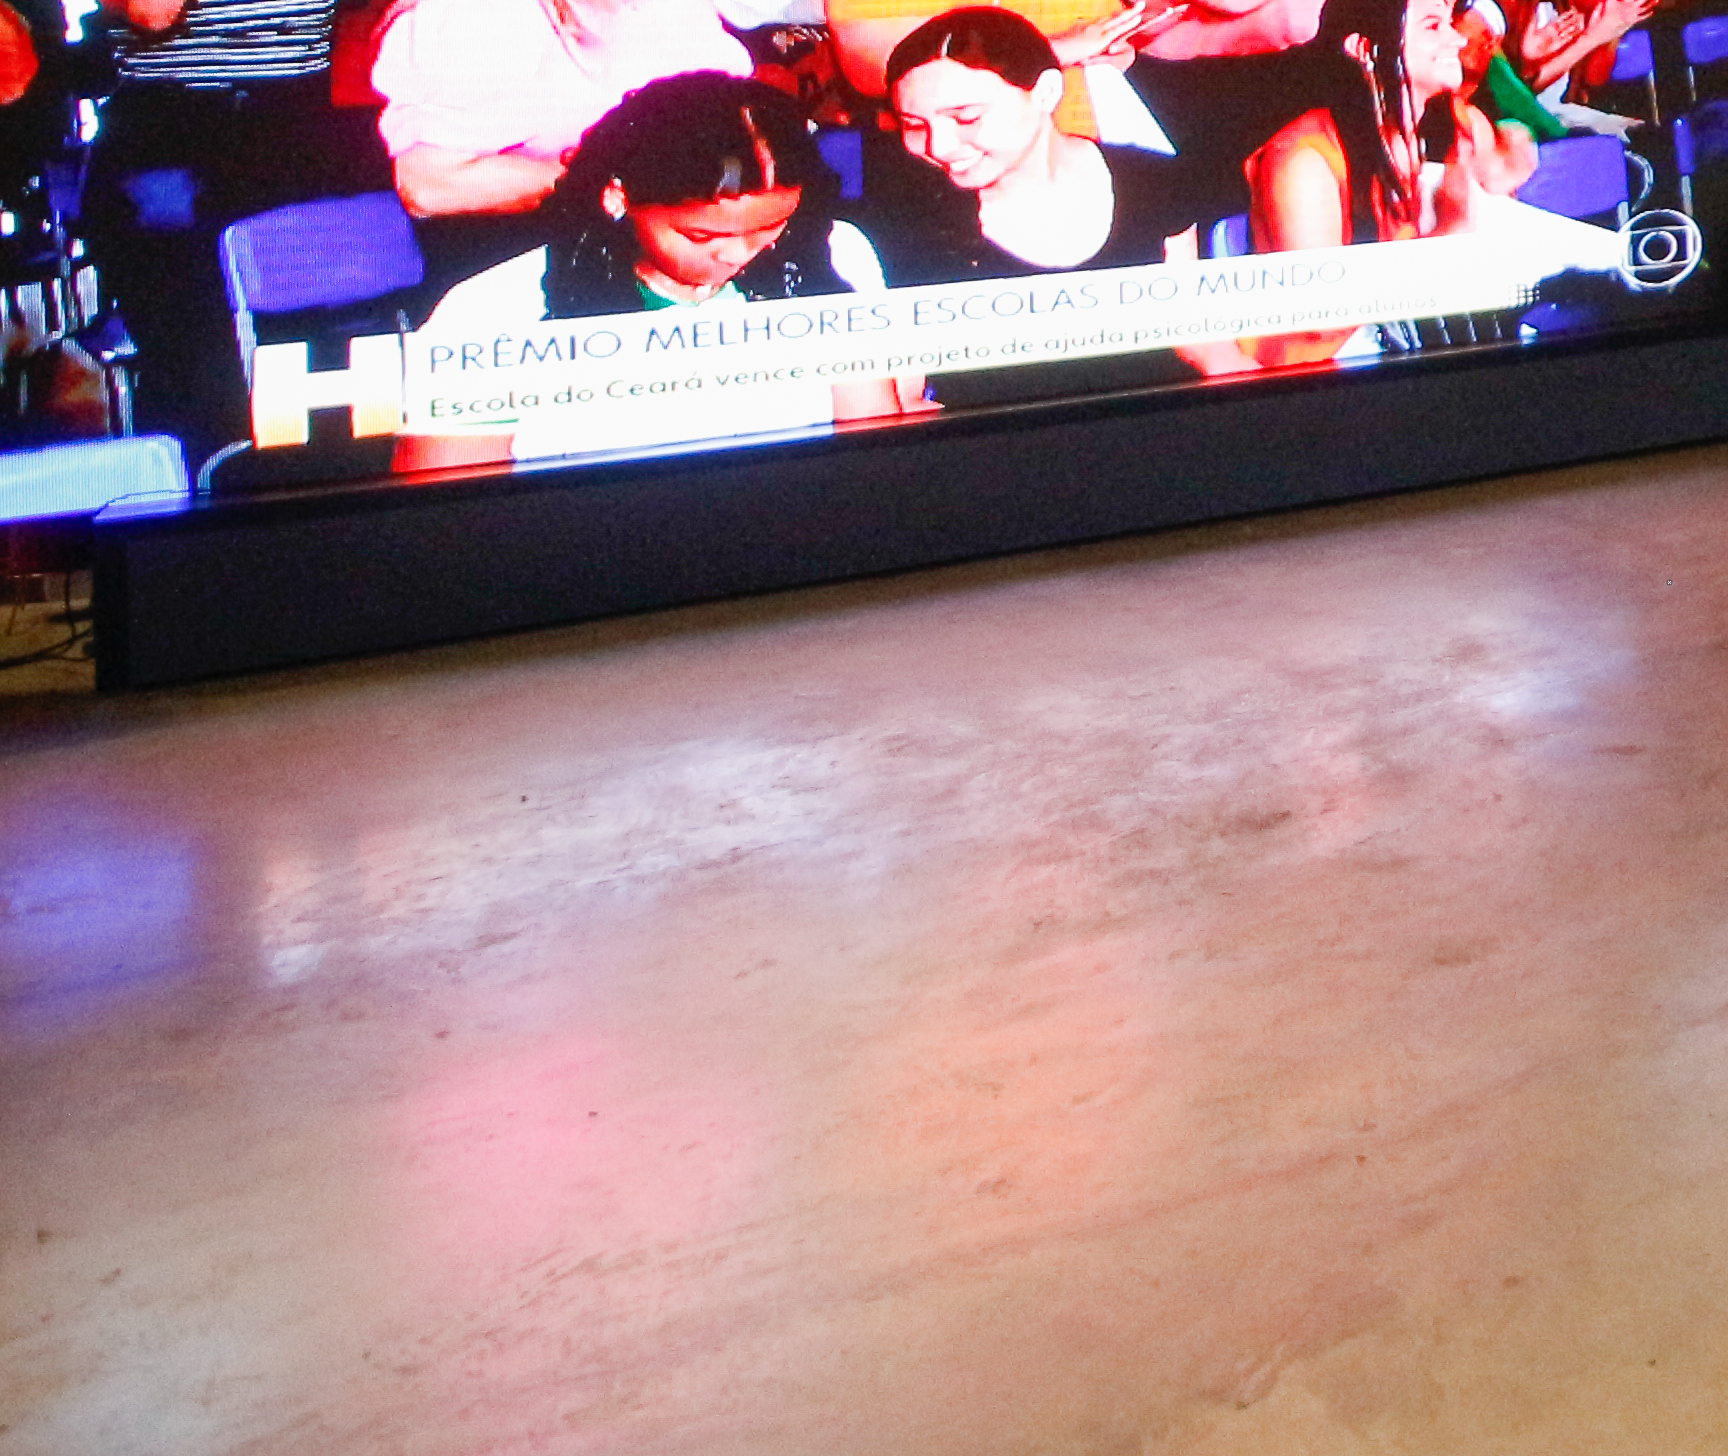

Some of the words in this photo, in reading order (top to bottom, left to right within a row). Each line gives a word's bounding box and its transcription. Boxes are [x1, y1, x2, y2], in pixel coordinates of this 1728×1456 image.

[430, 330, 622, 374] PRÊMIO
[645, 303, 891, 353] MELHORES
[913, 283, 1098, 327] ESCOLAS
[1119, 276, 1178, 305] DO
[1197, 260, 1346, 298] MUNDO
[430, 391, 539, 419] Escola
[553, 385, 594, 404] do
[605, 372, 702, 401] Ceará
[715, 366, 804, 386] vence
[815, 358, 876, 376] com
[887, 342, 991, 373] projeto
[1000, 338, 1034, 356] de
[1044, 328, 1124, 354] ajuda
[1133, 310, 1282, 345] psicológica
[1291, 306, 1349, 327] para
[1358, 296, 1439, 316] alunos
